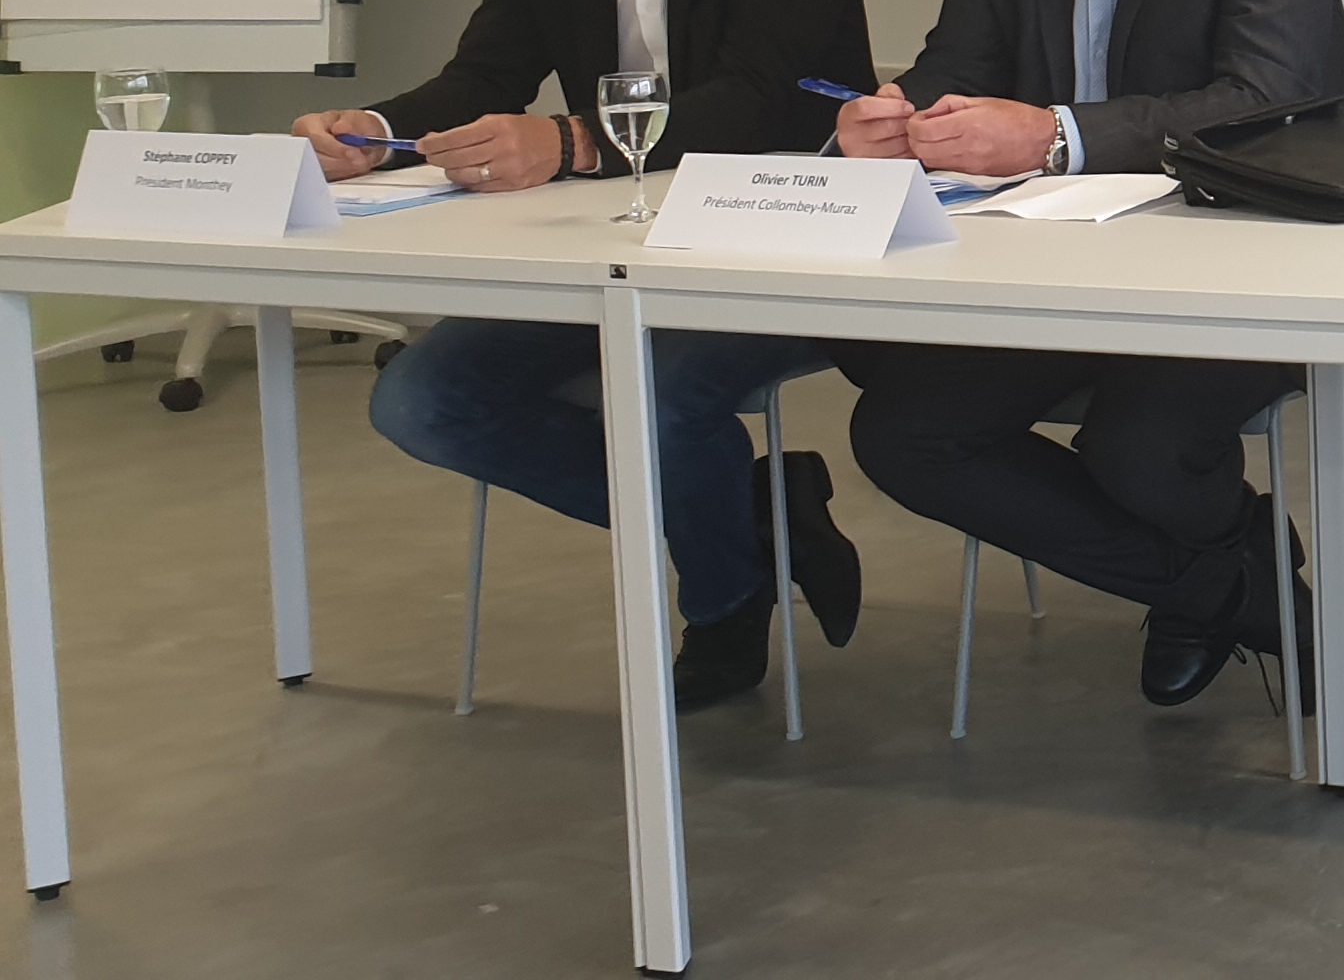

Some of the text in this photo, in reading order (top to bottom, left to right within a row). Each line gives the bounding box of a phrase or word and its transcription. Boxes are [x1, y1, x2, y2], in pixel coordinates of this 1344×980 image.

[194, 152, 238, 165] COPPEY
[751, 173, 828, 188] Olivier TURIN
[703, 196, 858, 215] Président Collombey-Muraz
